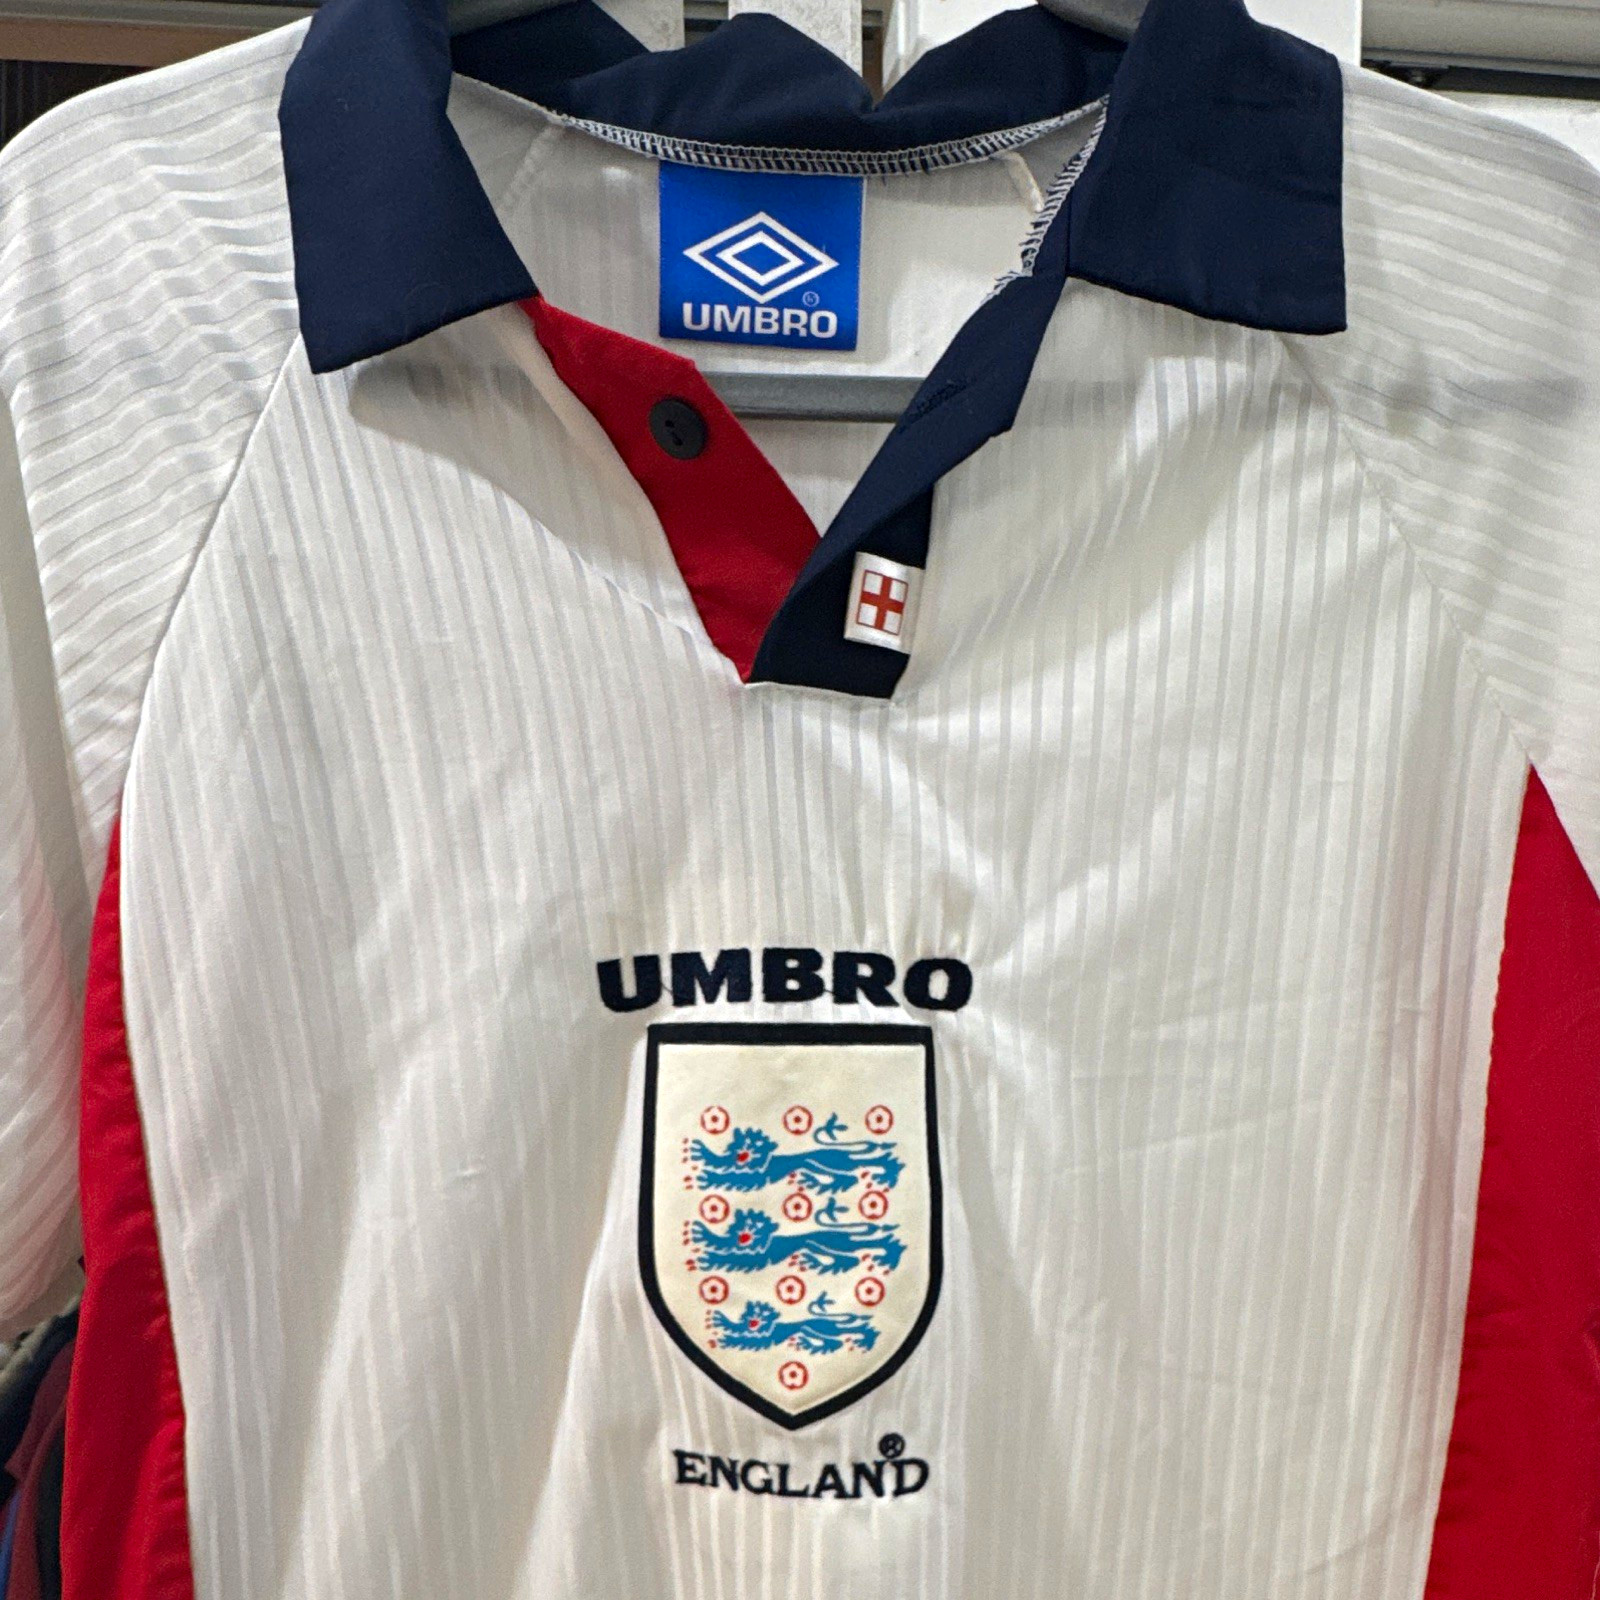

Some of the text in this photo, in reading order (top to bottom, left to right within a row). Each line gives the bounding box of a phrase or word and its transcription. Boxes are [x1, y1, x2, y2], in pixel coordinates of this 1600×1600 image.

[682, 302, 838, 339] UMBRO
[597, 947, 973, 1013] UMBRO
[673, 1449, 930, 1499] ENGLAND
